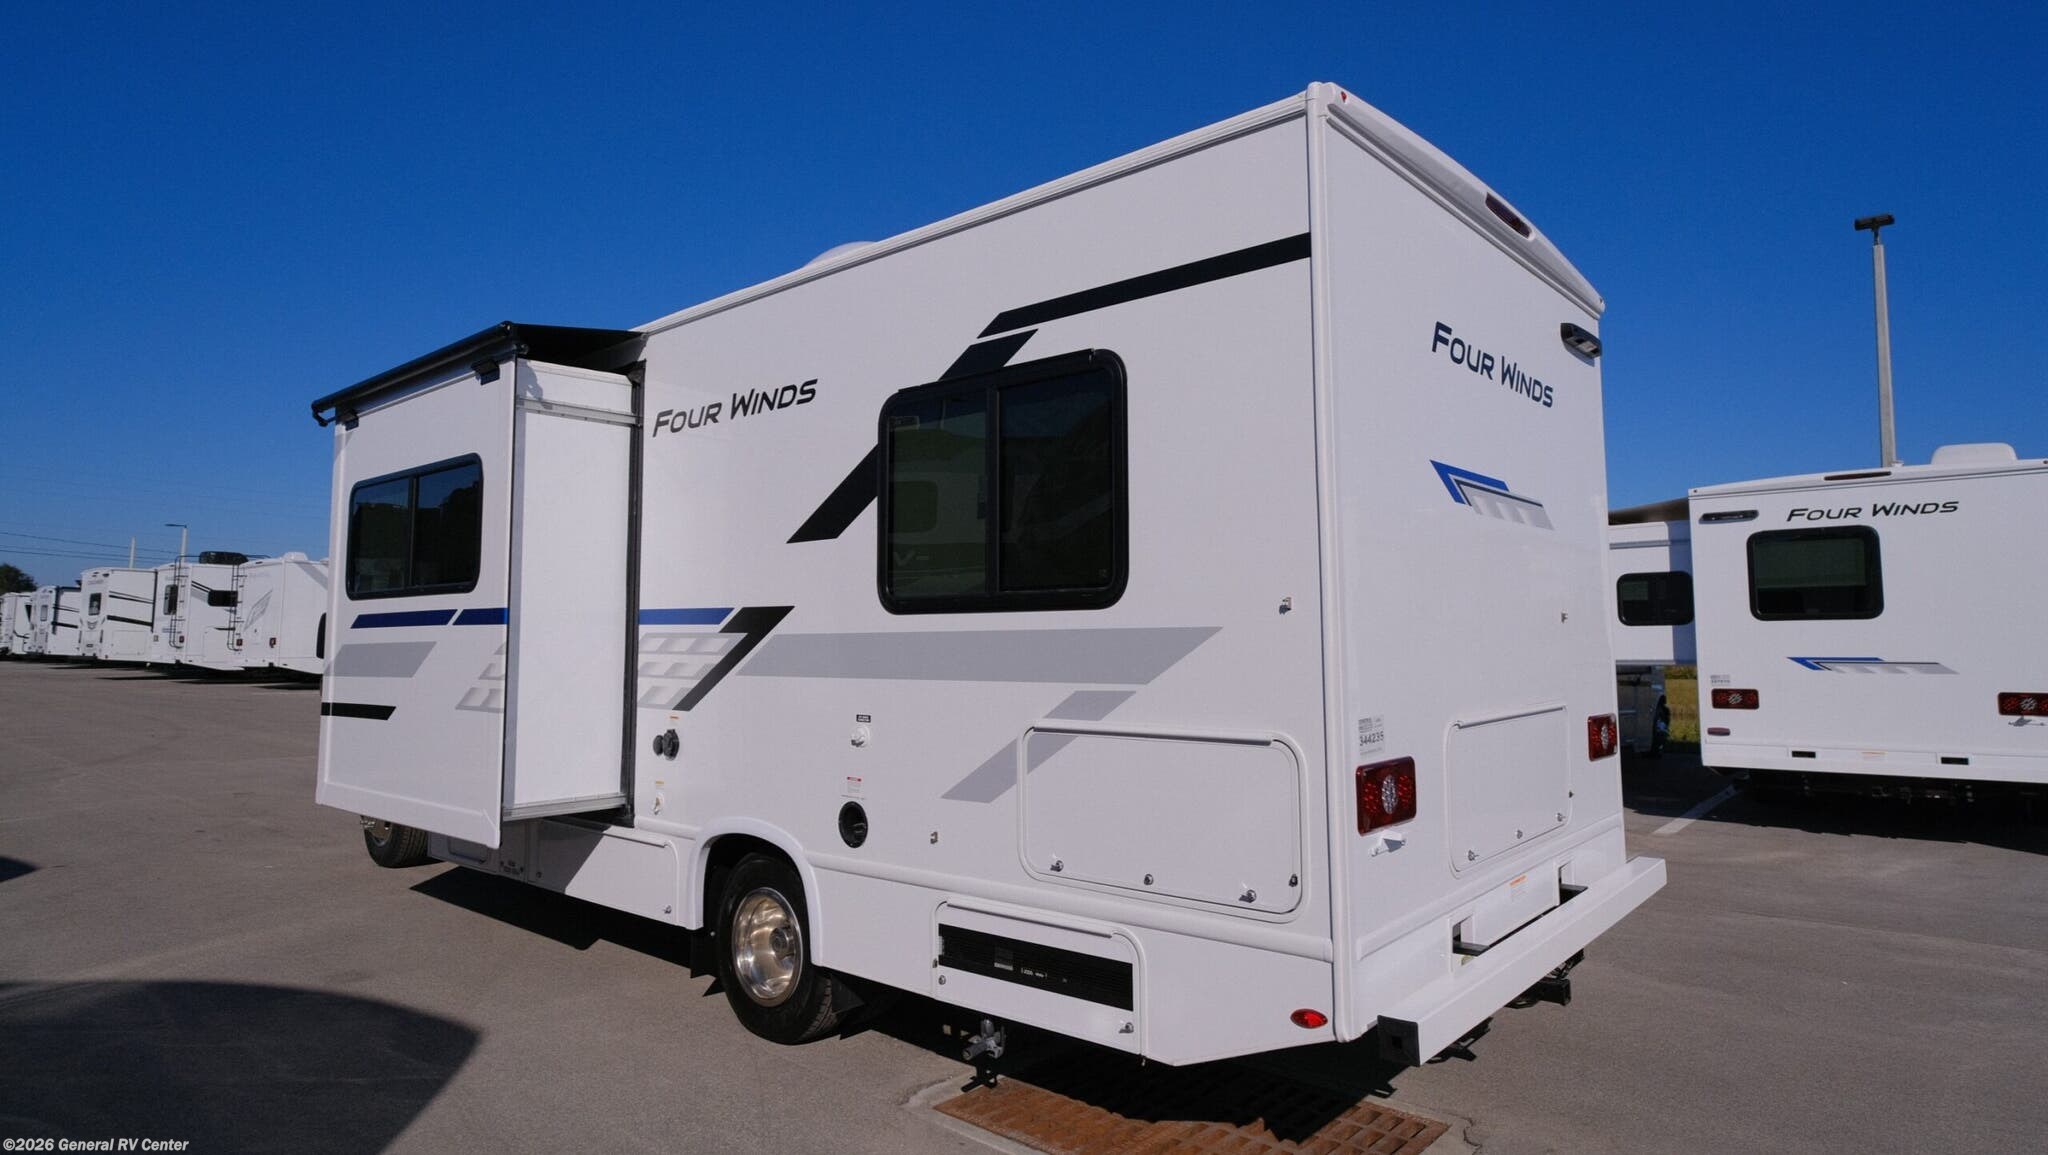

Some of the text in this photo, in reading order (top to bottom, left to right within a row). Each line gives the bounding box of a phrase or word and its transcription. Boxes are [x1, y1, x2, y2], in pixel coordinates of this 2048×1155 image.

[1431, 320, 1554, 408] FOUR WINDS
[652, 378, 818, 438] FOUR WINDS
[1786, 500, 1960, 522] FOUR WINDS
